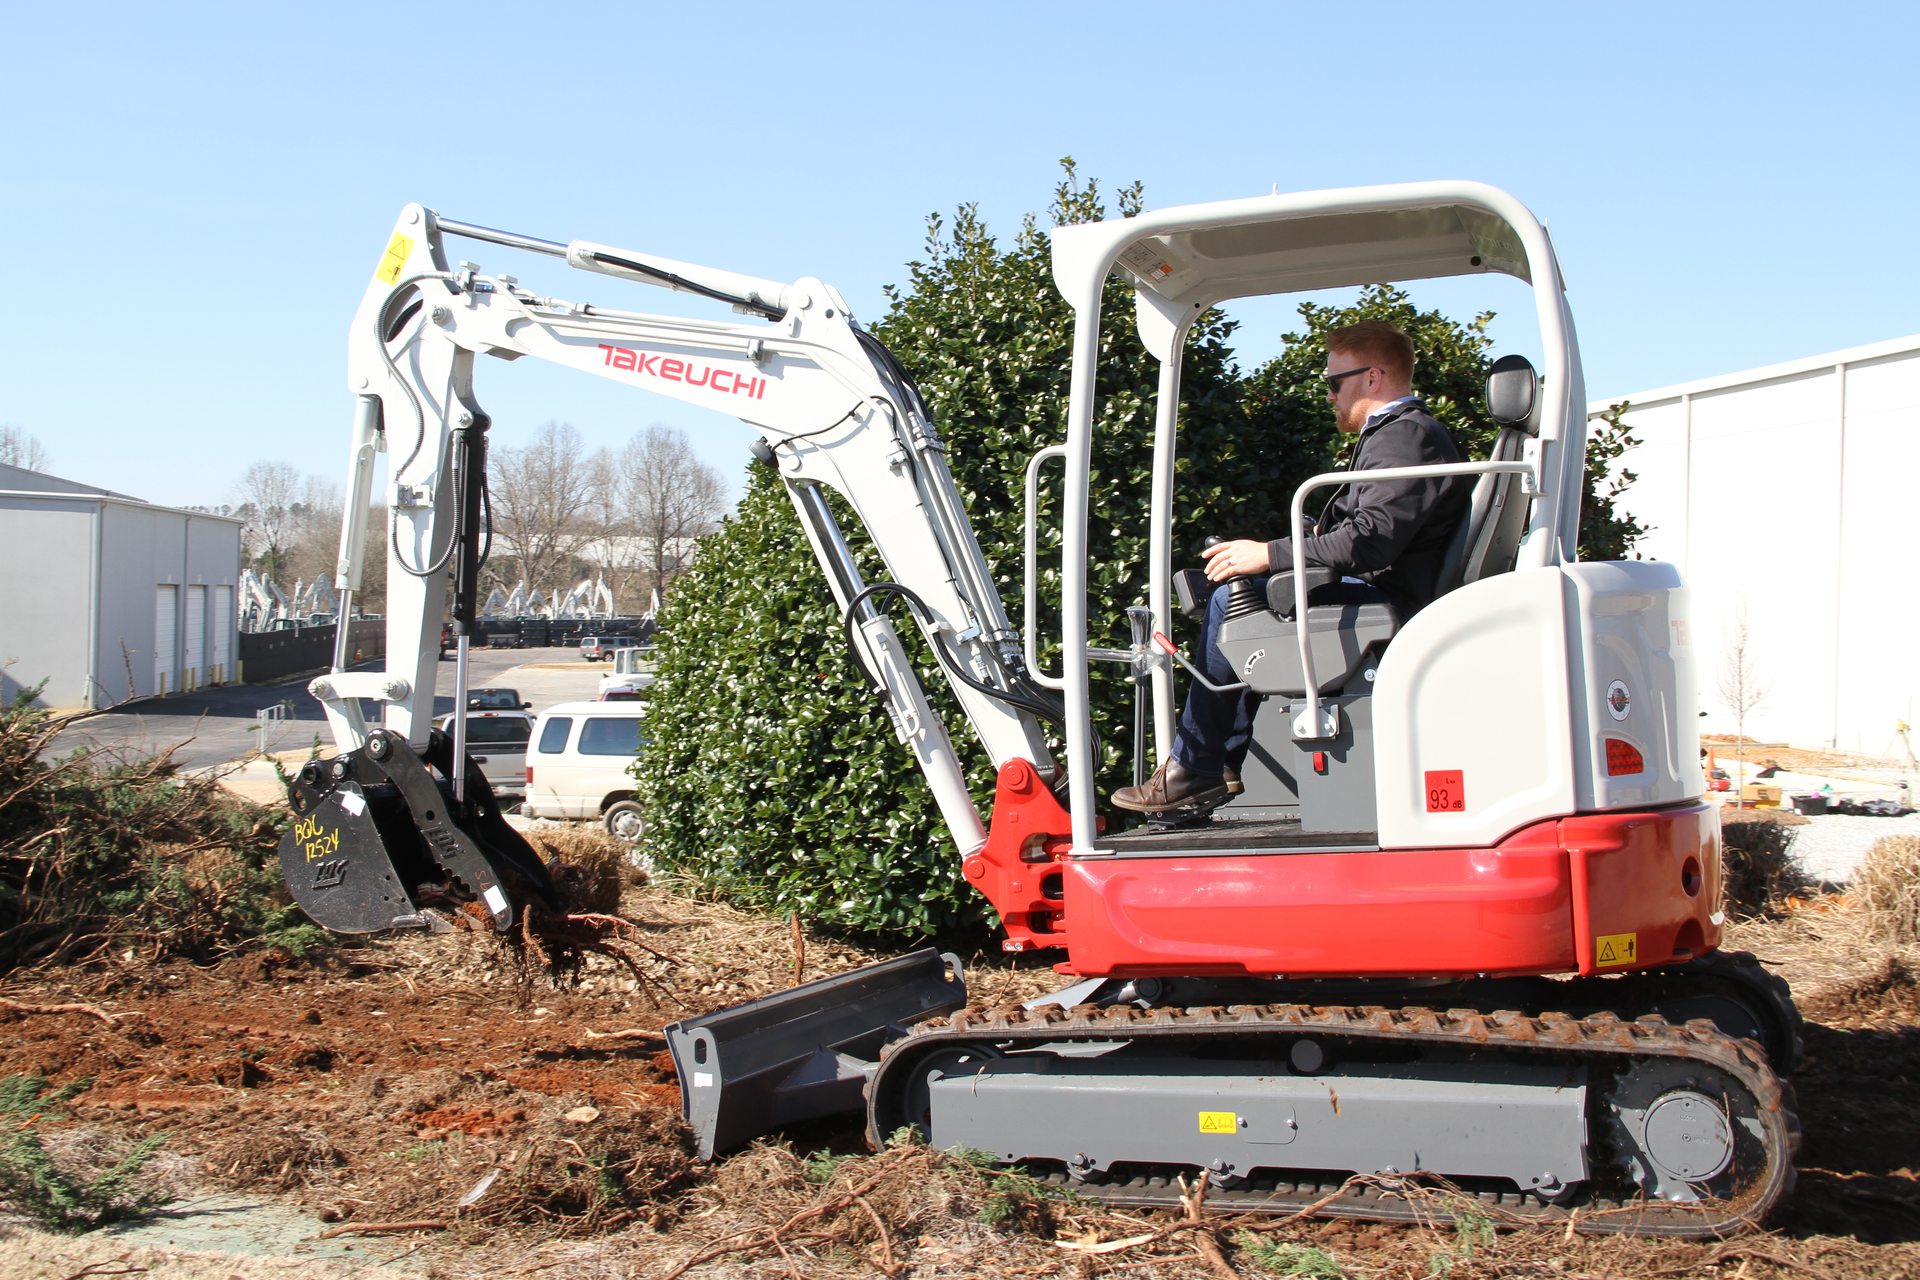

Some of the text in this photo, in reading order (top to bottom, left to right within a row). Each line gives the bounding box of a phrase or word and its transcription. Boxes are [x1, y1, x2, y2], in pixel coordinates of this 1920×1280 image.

[1430, 789, 1463, 809] 93 dB
[305, 828, 340, 863] 12524
